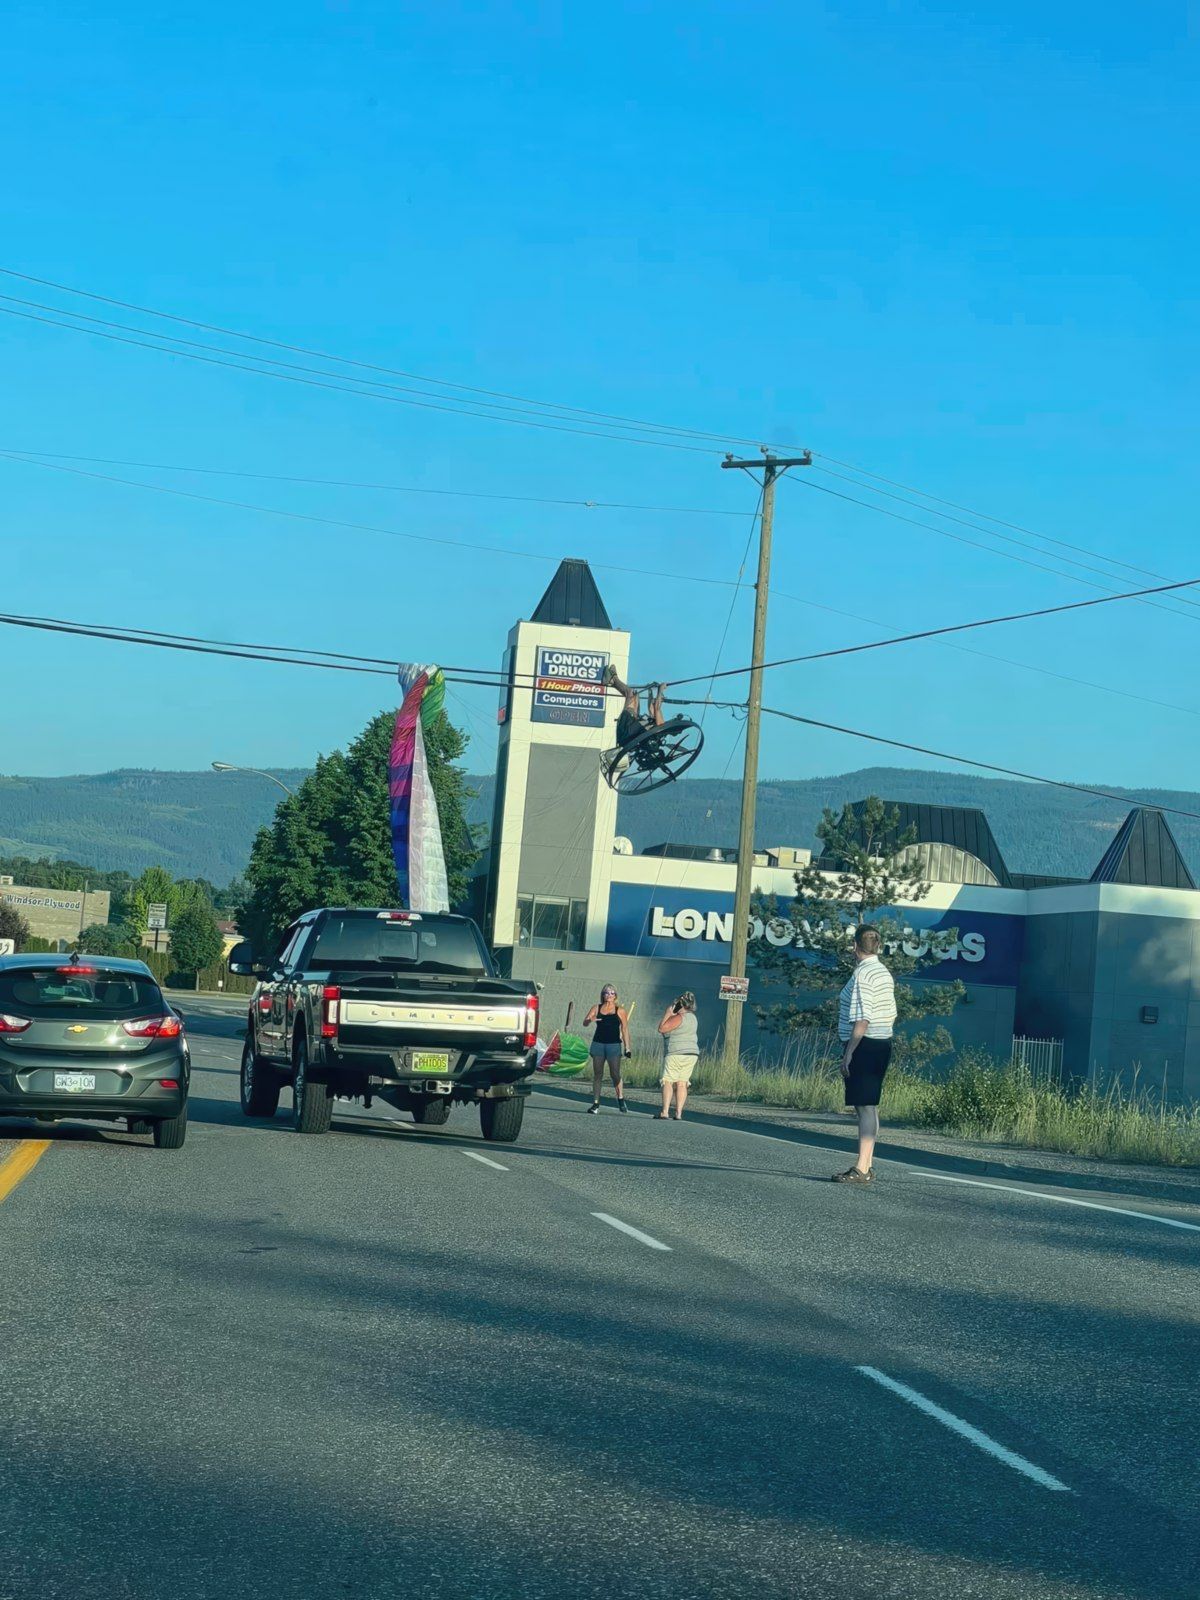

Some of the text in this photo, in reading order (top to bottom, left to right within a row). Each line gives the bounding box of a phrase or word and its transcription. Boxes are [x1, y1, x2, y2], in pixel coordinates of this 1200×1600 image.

[544, 652, 602, 668] LONDON
[548, 664, 597, 679] DRUGS
[541, 681, 602, 693] 1 Hour Photo
[542, 694, 599, 707] Computers
[6, 894, 81, 910] Windsor Plywood
[371, 1010, 495, 1021] LIMITED
